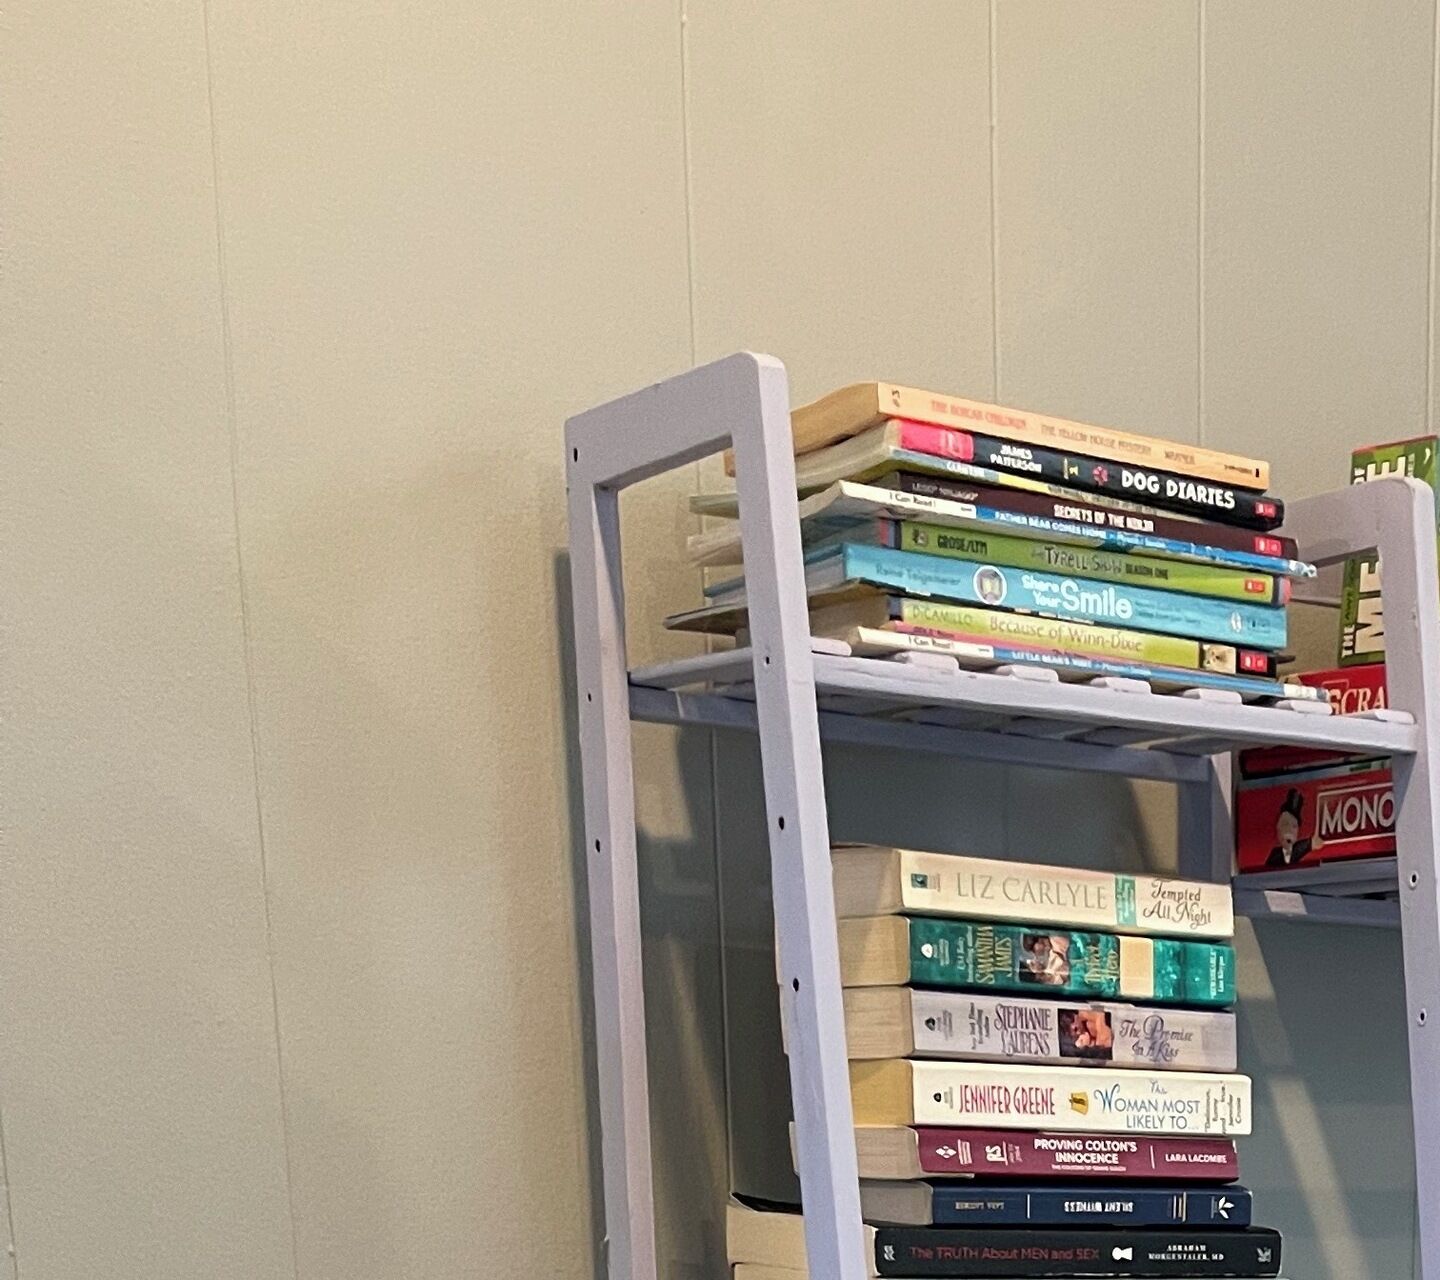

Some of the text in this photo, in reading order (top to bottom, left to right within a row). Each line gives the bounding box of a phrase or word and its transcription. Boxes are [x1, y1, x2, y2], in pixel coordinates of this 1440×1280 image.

[1000, 444, 1032, 459] JAMES
[990, 455, 1042, 474] PATTERSON
[1121, 469, 1160, 495] DOG
[1165, 478, 1235, 510] DIARIES
[1053, 504, 1092, 523] SECRETS
[1021, 574, 1059, 593] Share
[1033, 591, 1061, 608] Your
[1060, 577, 1134, 620] Smile
[990, 616, 1143, 653] Because of Winn-Dixie
[956, 872, 996, 900] LIZ
[1001, 878, 1108, 910] CARLYLE
[1149, 879, 1203, 904] Tempted
[1142, 902, 1213, 930] All Night
[993, 1003, 1054, 1033] STEPHANIE
[1118, 1015, 1193, 1043] The Promise
[999, 1029, 1052, 1058] LAURENS
[958, 1084, 1057, 1116] JENNIFER GREENE
[1094, 1089, 1201, 1115] WOMAN MOST
[1126, 1114, 1169, 1131] LIKELY
[1033, 1138, 1137, 1153] PROVING COLTON'S
[1054, 1152, 1119, 1165] INNOCENCE
[1164, 1152, 1227, 1165] LARA LACOMBE
[1063, 1200, 1134, 1215] SILENT WITNESS
[909, 1246, 1100, 1261] The TRUTH About MEN and SEX
